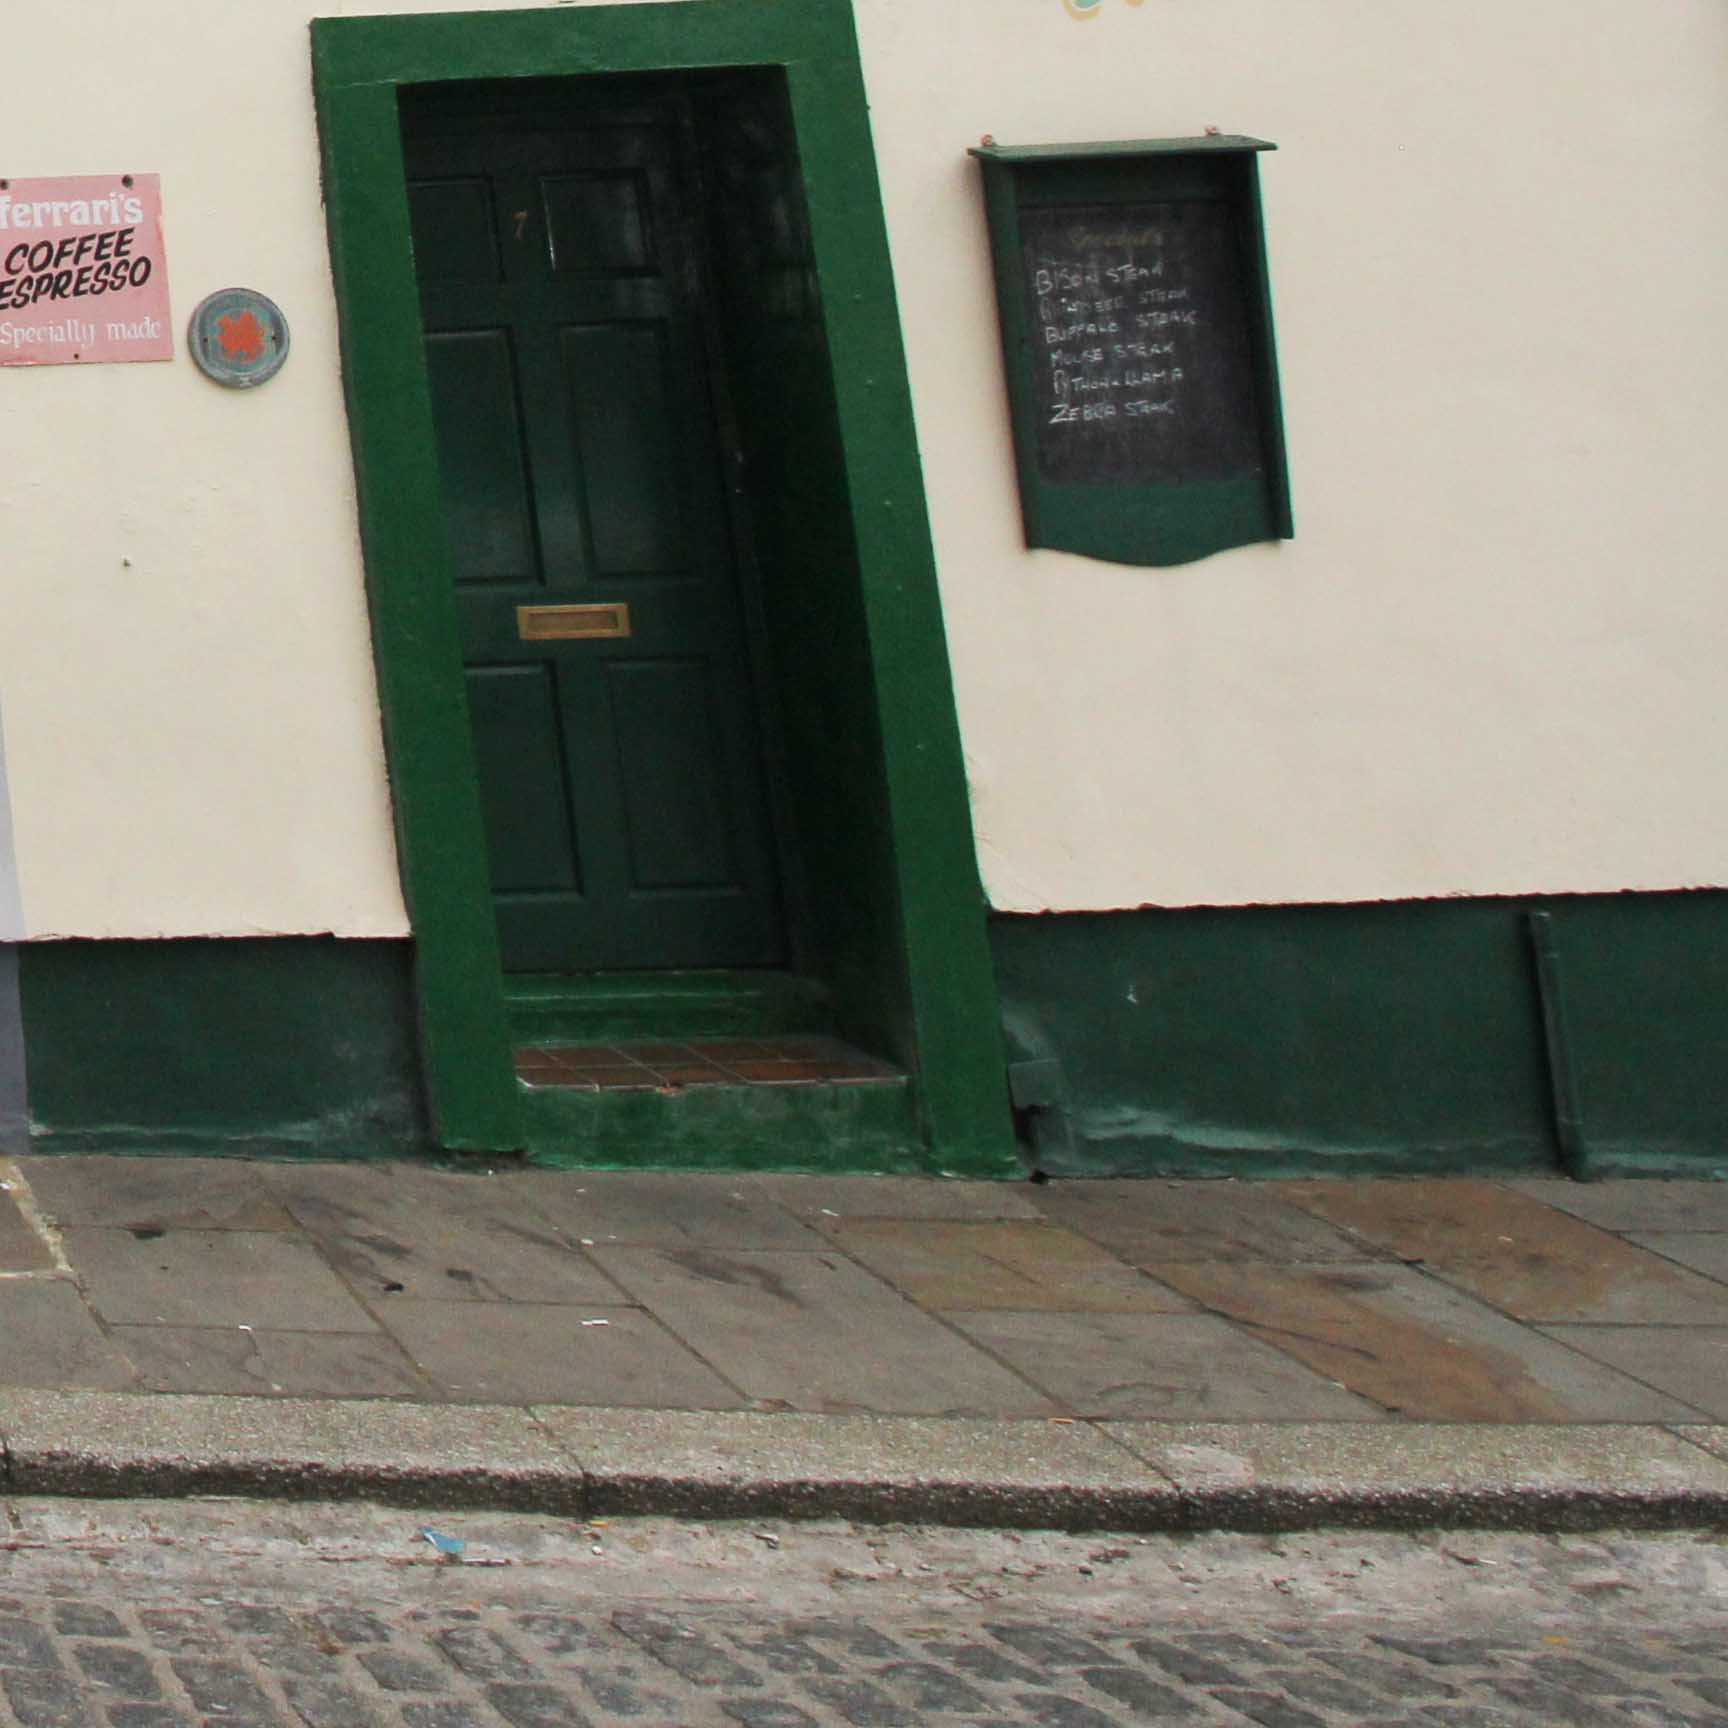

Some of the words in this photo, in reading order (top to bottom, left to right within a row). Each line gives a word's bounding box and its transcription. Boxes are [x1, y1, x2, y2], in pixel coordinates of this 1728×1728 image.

[511, 208, 529, 241] 7
[4, 227, 136, 276] COFFEE
[0, 319, 95, 350] Specially
[106, 316, 161, 340] made
